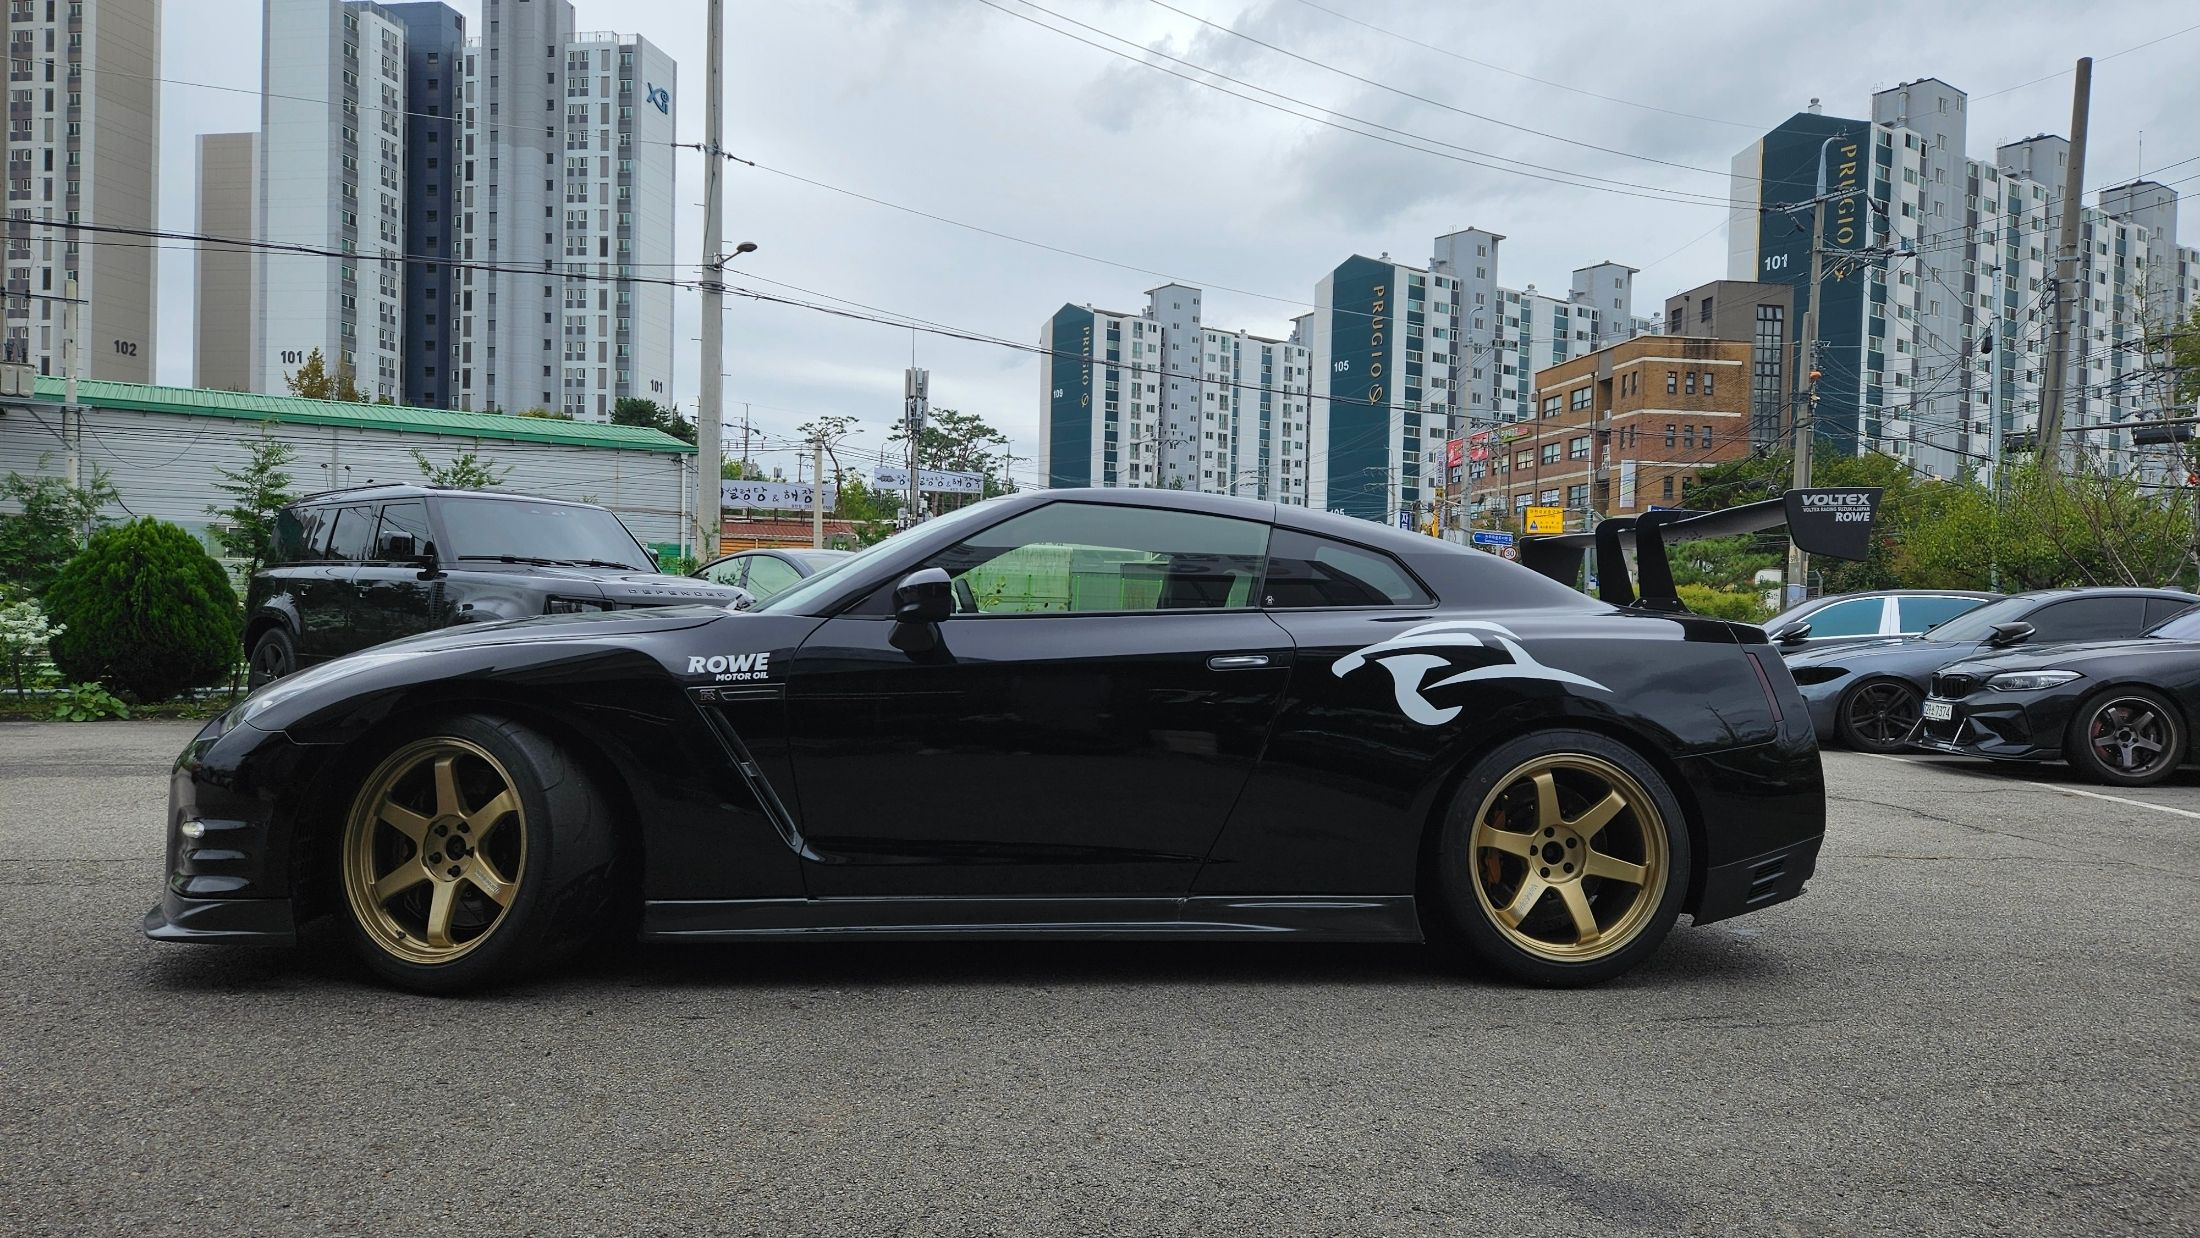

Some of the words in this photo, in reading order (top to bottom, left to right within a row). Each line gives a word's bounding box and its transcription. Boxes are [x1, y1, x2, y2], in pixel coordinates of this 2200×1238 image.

[1764, 253, 1788, 271] 101
[1371, 285, 1385, 377] PRUGIO
[113, 339, 137, 357] 102
[280, 350, 303, 364] 101
[1082, 326, 1090, 385] PRUGIO
[1334, 360, 1350, 373] 105
[650, 379, 663, 394] 101
[1053, 388, 1064, 399] 109
[721, 486, 768, 502] 설렁탕
[772, 494, 780, 503] &
[1801, 493, 1870, 505] VOLTEX
[1835, 512, 1871, 522] ROWE
[1505, 549, 1515, 558] 30
[687, 652, 771, 673] ROWE
[715, 673, 752, 681] MOTOR
[752, 671, 769, 679] OIL
